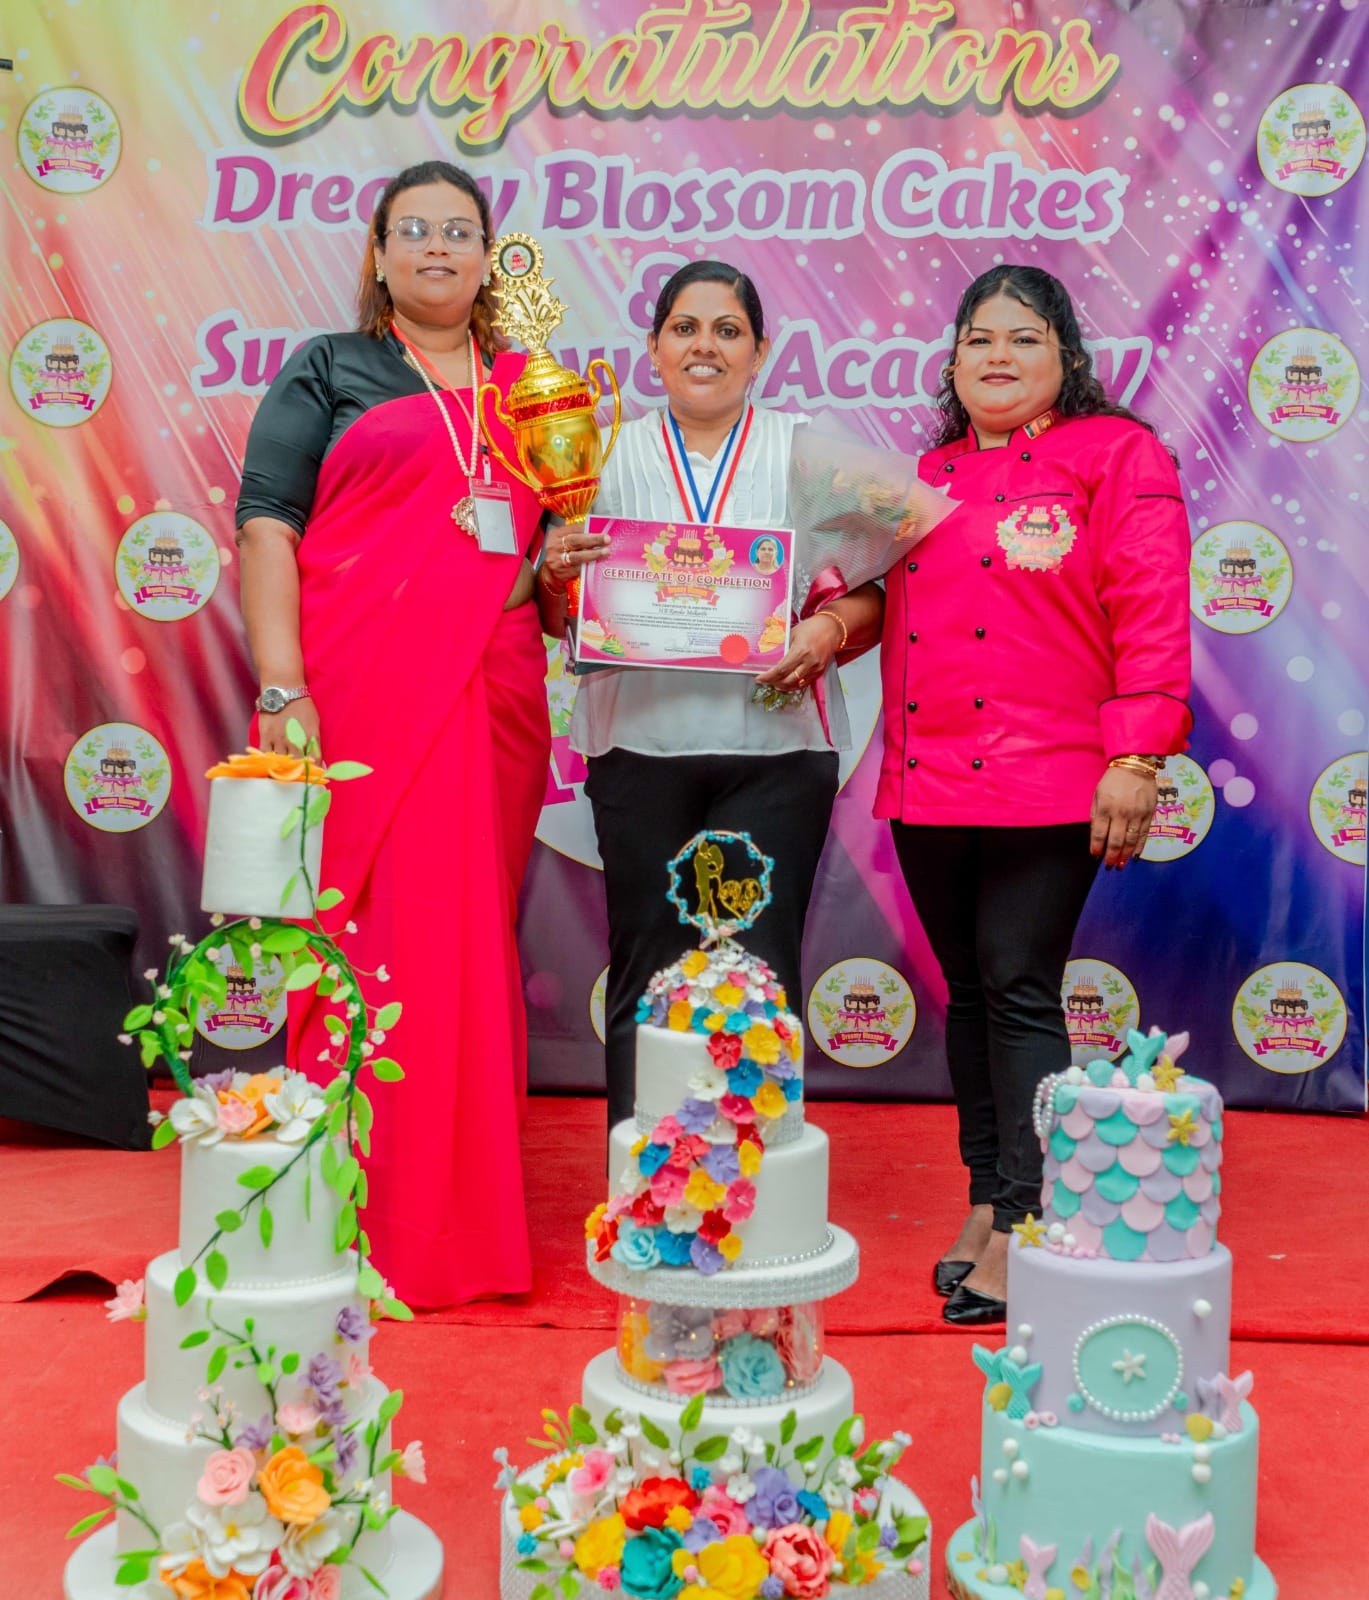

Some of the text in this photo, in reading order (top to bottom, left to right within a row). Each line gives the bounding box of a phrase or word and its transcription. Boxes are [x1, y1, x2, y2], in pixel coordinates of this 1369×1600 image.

[239, 0, 1119, 145] Congratulations
[542, 160, 856, 233] Blossom
[882, 159, 1115, 233] Cakes
[604, 568, 771, 589] CERTIFICATE OF COMPLETION
